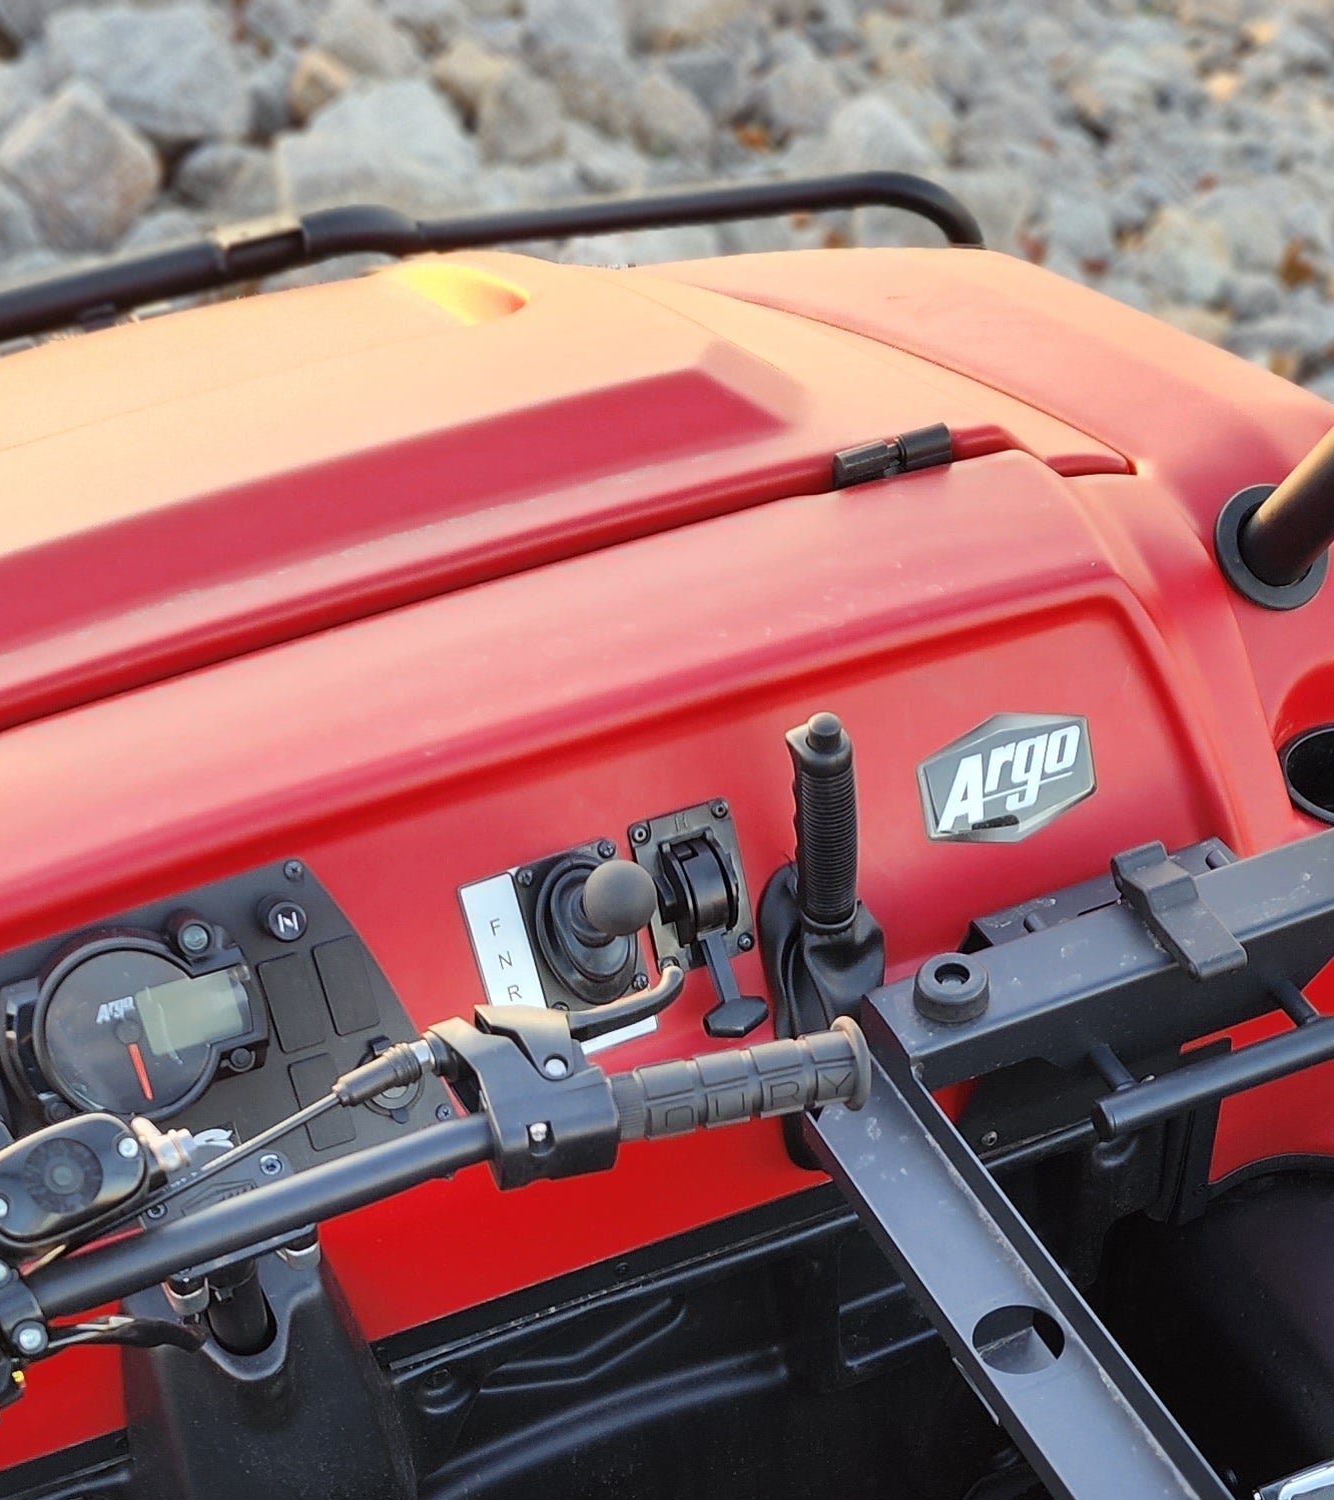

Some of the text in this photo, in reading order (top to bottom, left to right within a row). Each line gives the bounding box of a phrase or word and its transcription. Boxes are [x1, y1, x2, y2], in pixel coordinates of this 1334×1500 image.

[937, 725, 1081, 833] Argo
[490, 918, 501, 936] F
[498, 950, 513, 970] N
[506, 984, 523, 1002] R
